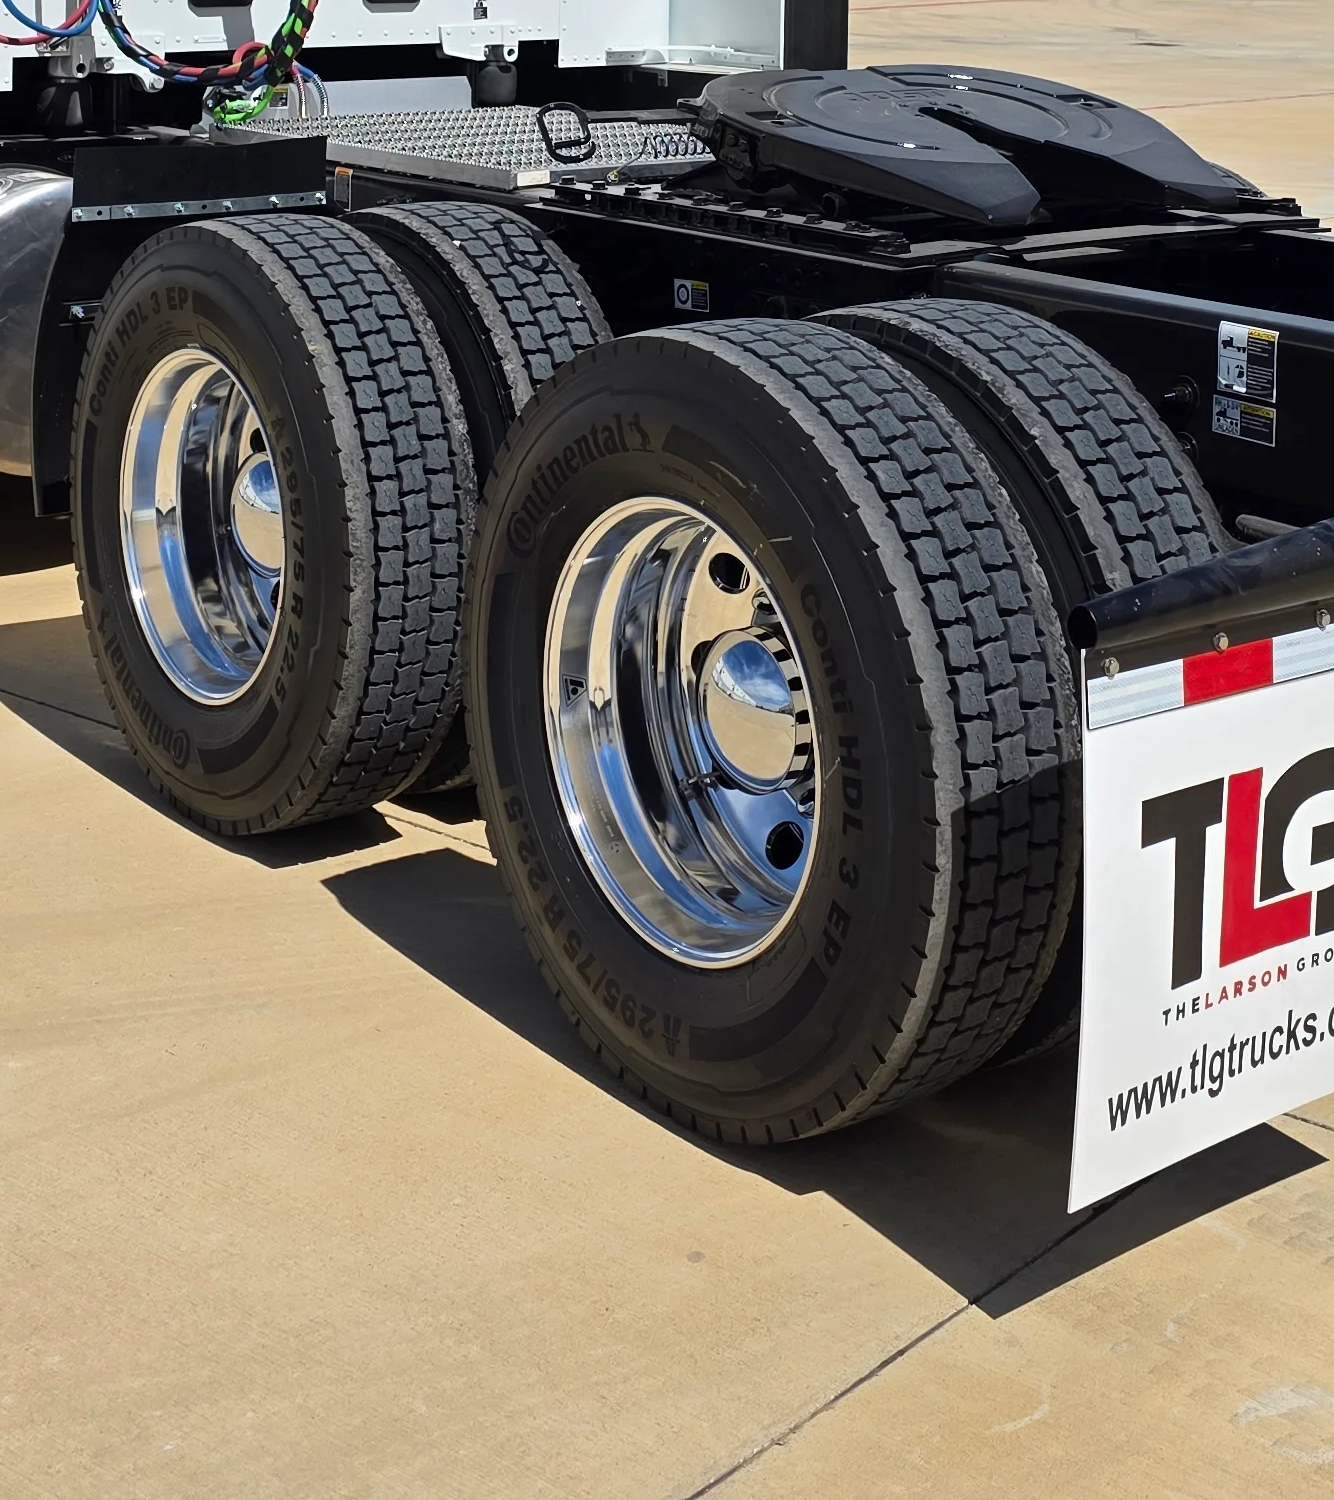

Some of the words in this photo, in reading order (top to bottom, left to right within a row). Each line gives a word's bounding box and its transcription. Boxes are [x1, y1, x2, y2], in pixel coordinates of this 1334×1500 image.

[89, 339, 119, 416] Conti
[115, 300, 150, 347] HDL
[150, 289, 161, 315] 3
[165, 286, 189, 311] EP
[280, 446, 306, 581] 295/75
[506, 412, 630, 559] Continental
[290, 600, 304, 621] R
[800, 583, 854, 714] Conti
[104, 633, 191, 771] Continental
[273, 630, 300, 705] 22.5
[838, 735, 864, 837] HDL
[504, 796, 550, 893] 22.5
[838, 856, 860, 891] 3
[542, 894, 565, 933] R
[821, 898, 852, 968] EP
[562, 928, 658, 1040] 295/75
